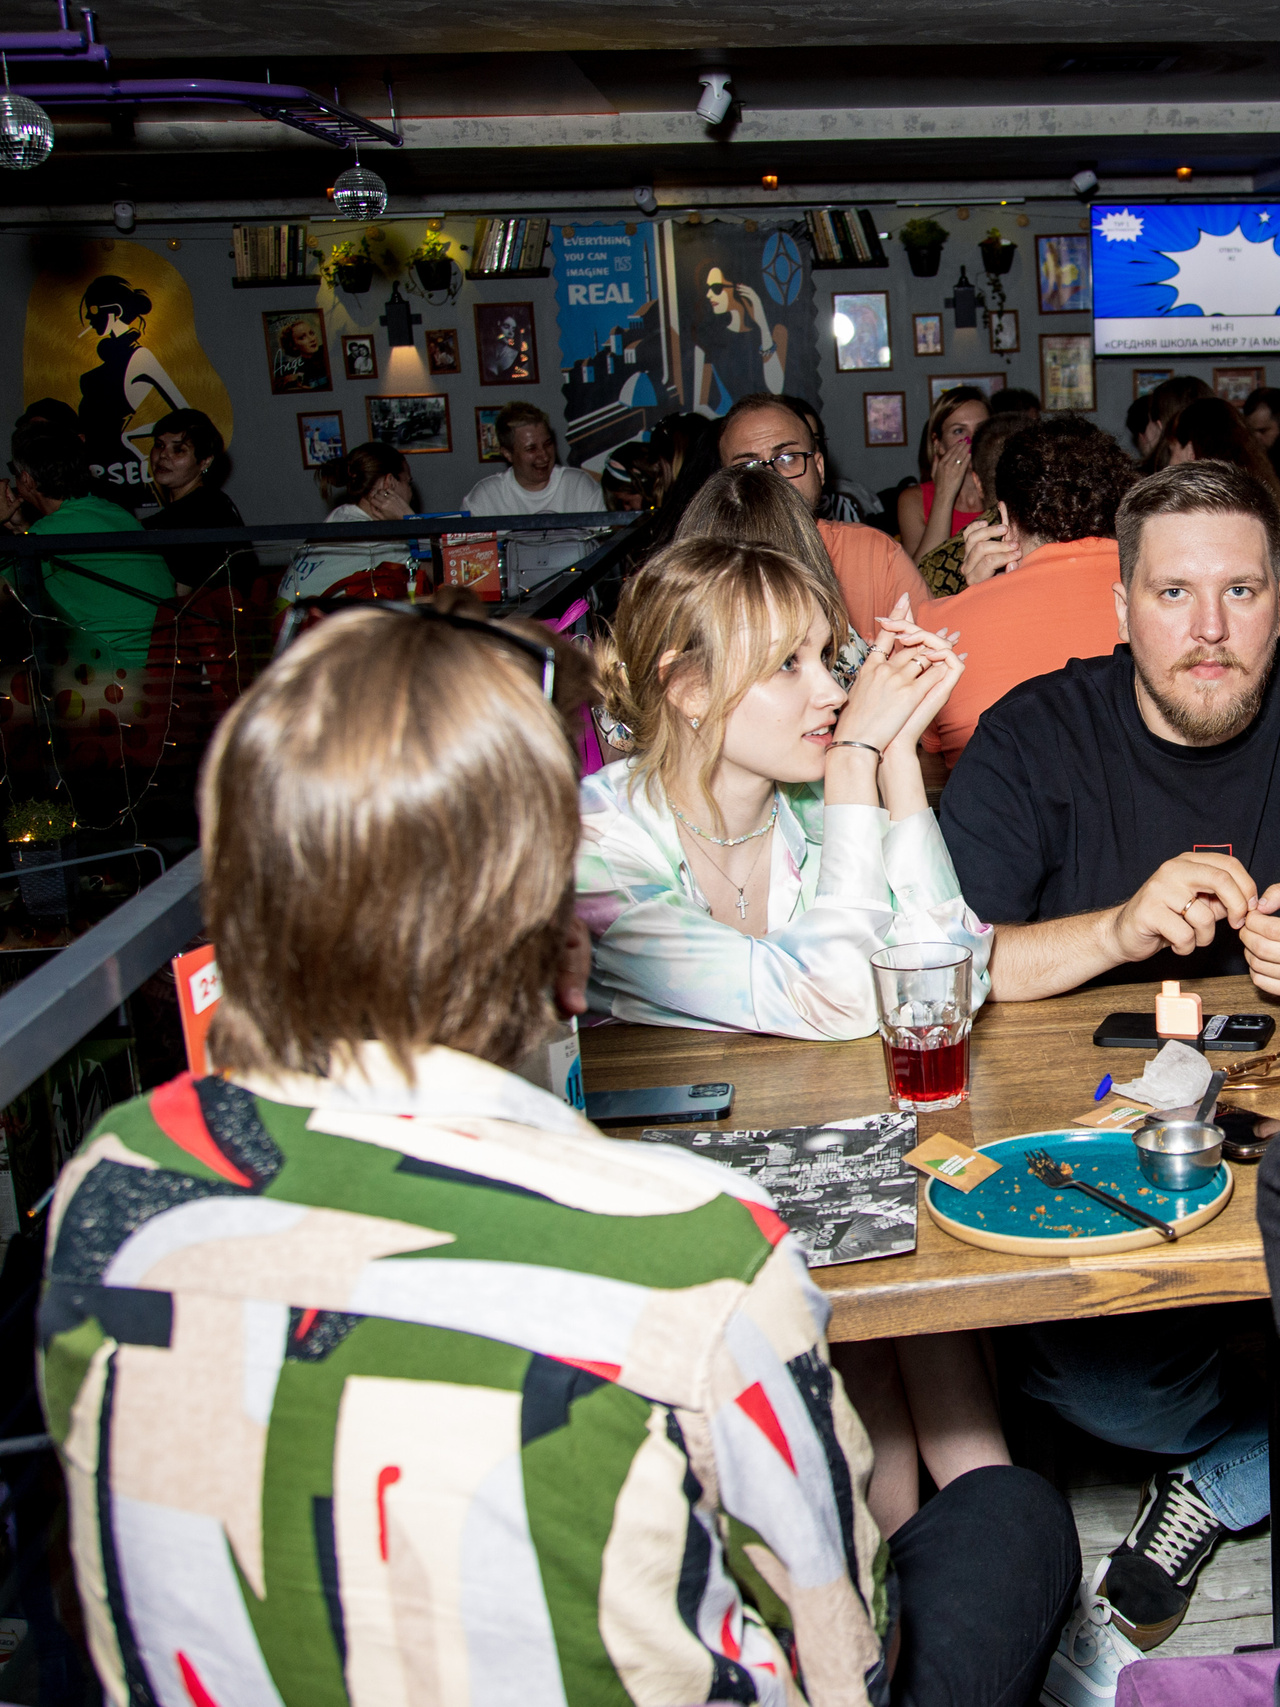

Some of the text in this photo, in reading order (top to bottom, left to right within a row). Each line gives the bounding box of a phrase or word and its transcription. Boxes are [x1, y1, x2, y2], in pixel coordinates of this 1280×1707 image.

[564, 252, 608, 262] YOU CAN
[568, 282, 634, 306] REAL
[1211, 323, 1234, 332] HI-FI
[1105, 338, 1158, 350] «СРЕДНЯЯ
[1161, 338, 1199, 349] ШКОЛА
[1201, 338, 1240, 348] НОМЕР
[1242, 337, 1248, 347] 7
[1250, 337, 1261, 348] (А
[733, 1129, 773, 1138] CITY
[692, 1133, 712, 1147] 5
